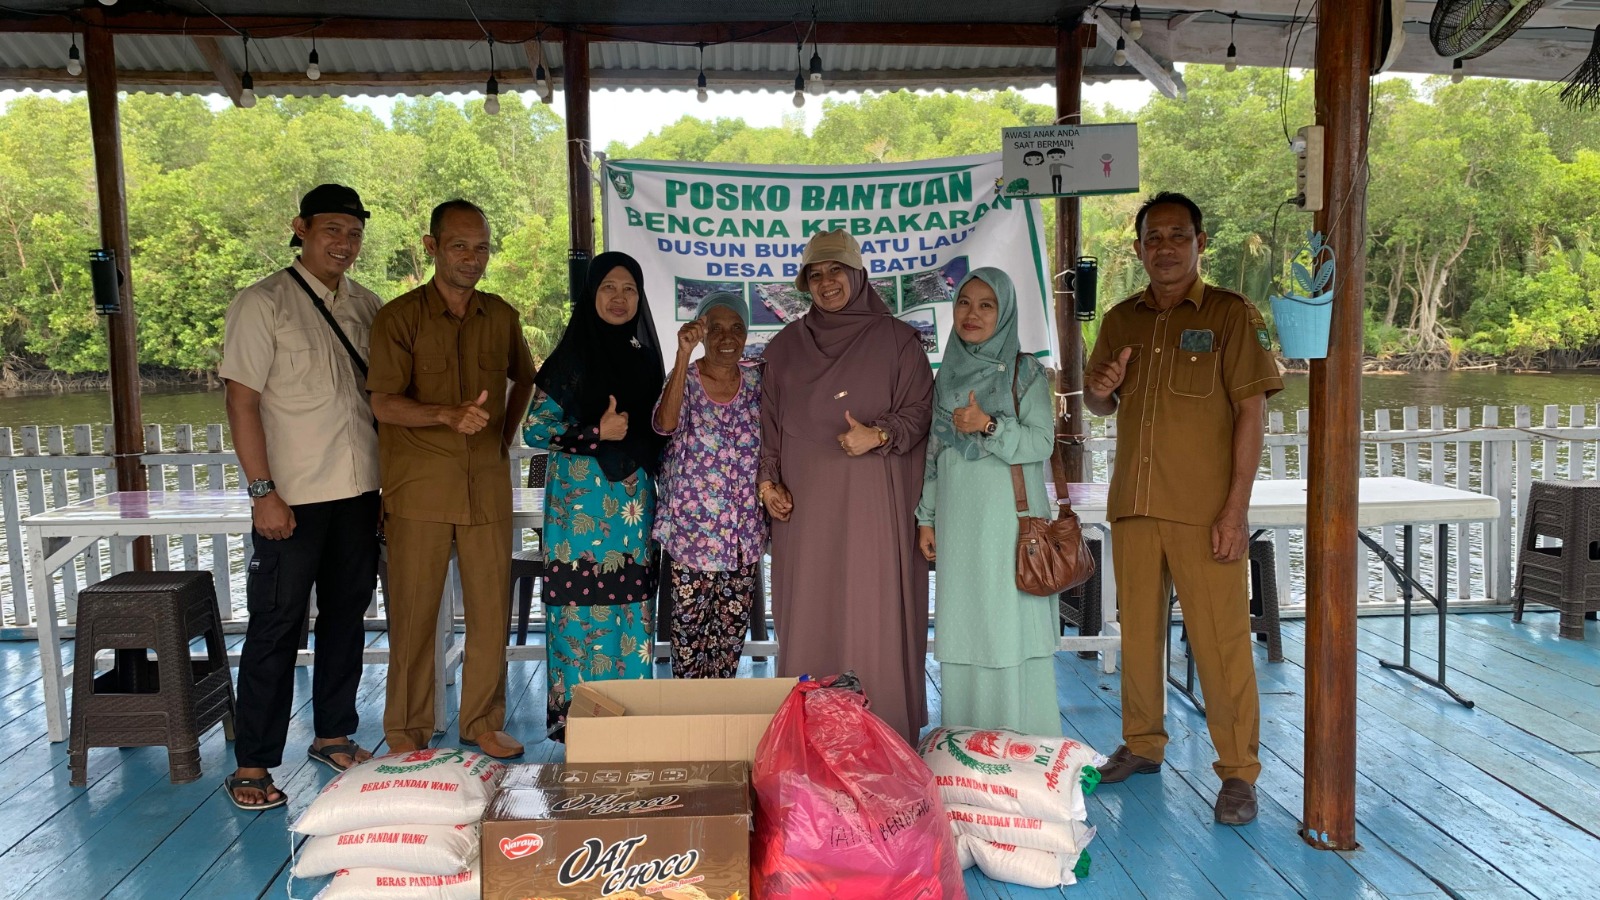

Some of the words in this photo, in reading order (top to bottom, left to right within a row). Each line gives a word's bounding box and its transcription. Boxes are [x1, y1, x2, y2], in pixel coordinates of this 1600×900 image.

[1004, 131, 1031, 139] AWASI
[1033, 130, 1055, 138] ANAK
[1057, 129, 1080, 137] ANDA
[1014, 141, 1034, 150] SAAT
[1037, 139, 1074, 149] BERMAIN
[665, 179, 790, 212] POSKO
[801, 171, 973, 211] BANTUAN
[625, 206, 790, 238] BENCANA
[802, 193, 1012, 237] KEBAKARAN
[658, 238, 746, 257] DUSUN
[755, 243, 805, 257] BUK
[861, 239, 910, 254] ATU
[706, 262, 773, 277] DESA
[870, 254, 938, 273] BATU
[360, 780, 391, 793] BERAS
[392, 779, 428, 789] PANDAN
[430, 782, 460, 792] WANGI
[935, 775, 954, 787] RAS
[955, 776, 988, 792] PANDAN
[990, 784, 1018, 799] WANGI
[947, 812, 974, 823] BERAS
[976, 815, 1011, 828] PANDAN
[1013, 819, 1043, 830] WANGI
[337, 834, 365, 846] BERAS
[366, 833, 400, 844] PANDAN
[401, 833, 428, 845] WANGI
[503, 839, 541, 852] Naraya
[558, 835, 648, 887] OAT
[376, 876, 406, 886] BERAS
[409, 875, 443, 886] PANDAN
[444, 871, 472, 885] WANGI
[600, 849, 701, 896] CHOCO
